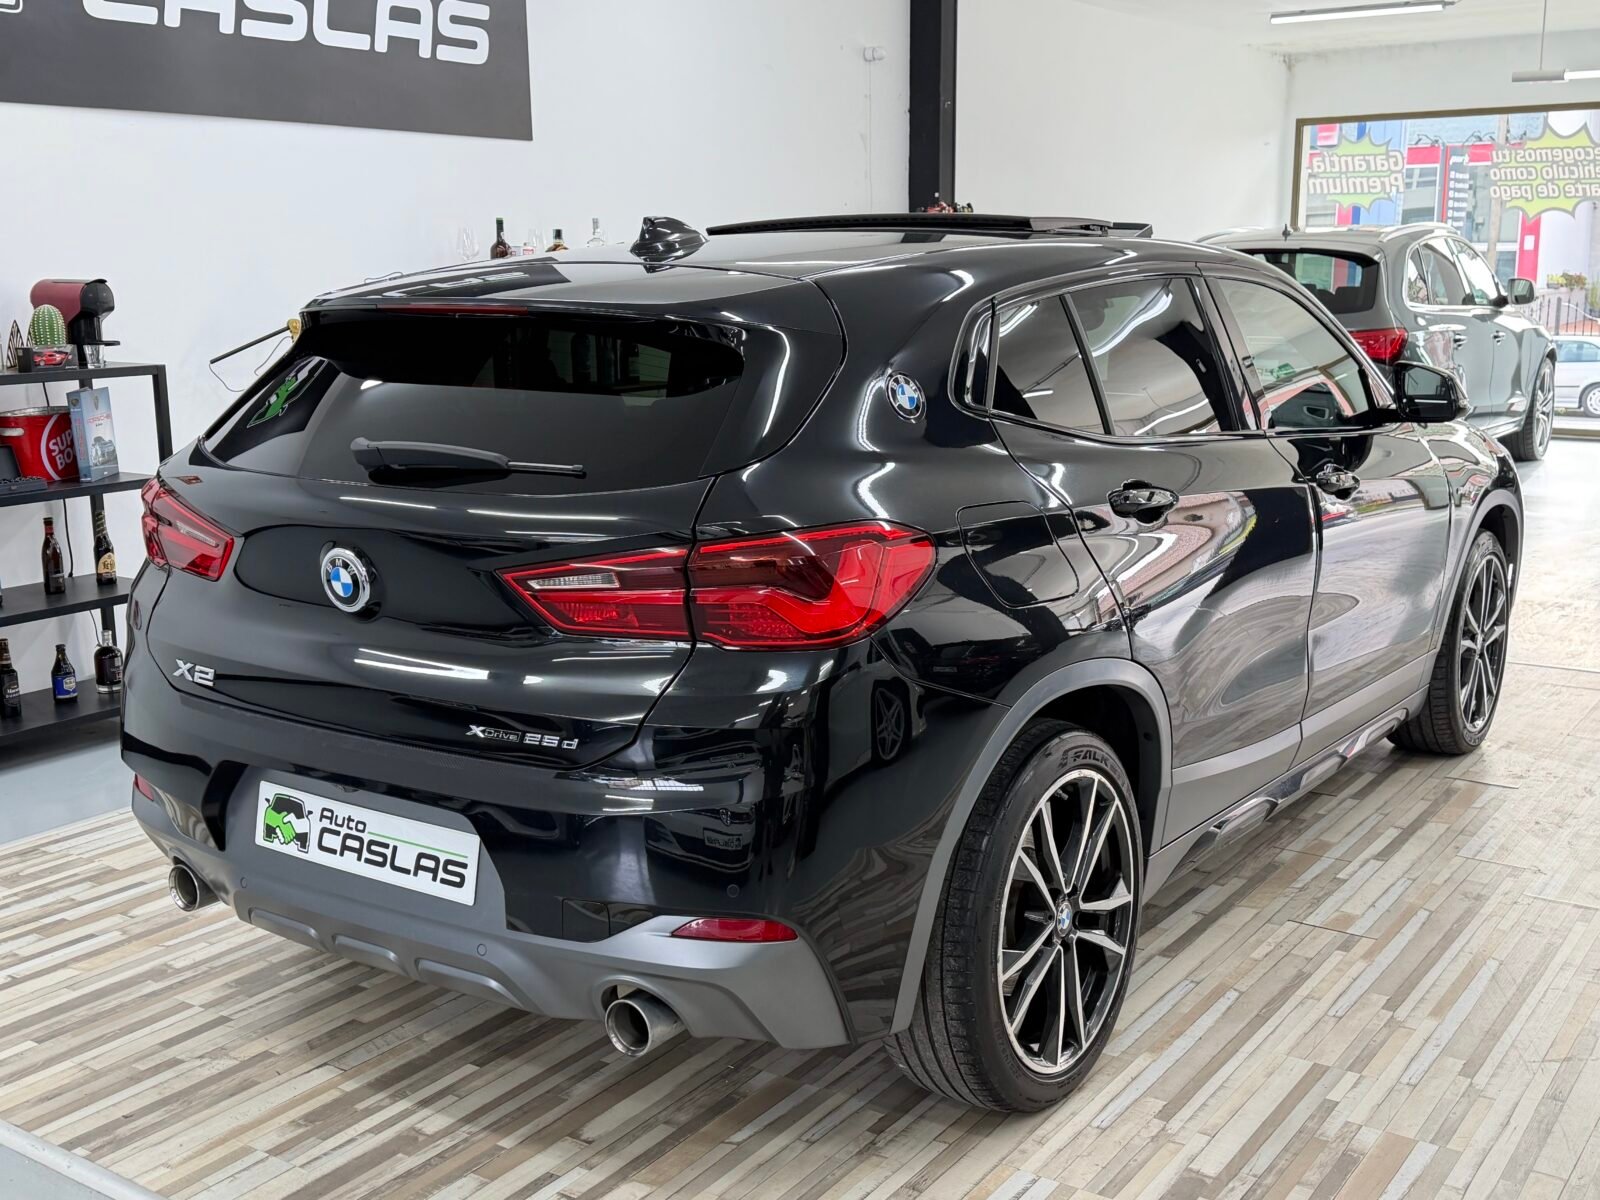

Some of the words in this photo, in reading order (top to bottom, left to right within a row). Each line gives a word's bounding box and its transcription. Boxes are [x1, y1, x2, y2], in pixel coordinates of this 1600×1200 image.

[326, 558, 356, 576] BMW
[172, 658, 215, 687] X2
[319, 807, 367, 834] Auto
[317, 826, 469, 889] CASLAS
